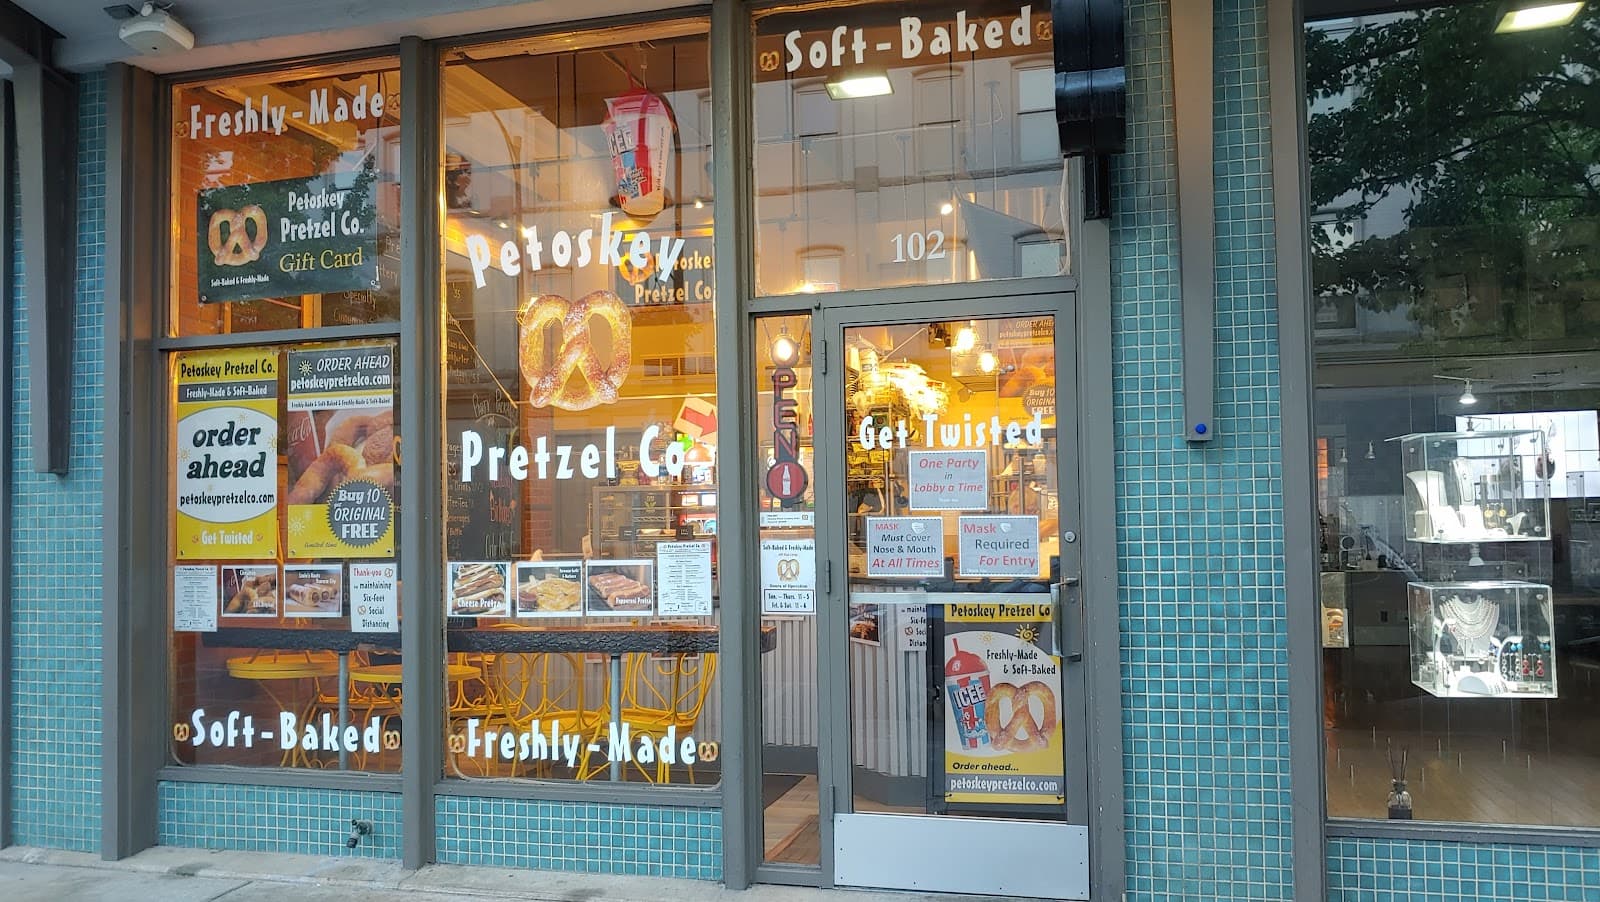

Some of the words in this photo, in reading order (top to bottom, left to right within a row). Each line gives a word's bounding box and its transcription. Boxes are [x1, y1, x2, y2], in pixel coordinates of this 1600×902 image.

[785, 5, 1032, 72] Soft-Baked
[190, 85, 384, 139] Freshly-Made
[288, 189, 345, 212] Petoskey
[280, 214, 336, 242] Pretzel
[340, 212, 364, 235] Co.
[466, 212, 685, 288] Petoskey
[890, 229, 946, 263] 102
[279, 252, 315, 273] Gift
[320, 247, 363, 271] Card
[655, 251, 711, 272] oske
[635, 282, 689, 304] Pretzel
[1016, 320, 1037, 329] ORDER
[181, 360, 221, 378] Petoskey
[224, 359, 258, 376] Pretzel
[261, 358, 275, 374] Co.
[317, 356, 352, 373] ORDER
[354, 354, 390, 371] AHEAD
[290, 372, 391, 392] petoskeypretzelco.com
[186, 386, 226, 399] Freshly-Made
[226, 386, 232, 396] &
[233, 385, 267, 396] Soft-Baked
[1029, 389, 1045, 397] Buy
[1046, 388, 1055, 397] 10
[1032, 406, 1055, 415] FREE
[193, 421, 261, 447] order
[859, 416, 909, 450] Get
[922, 412, 1042, 448] Twisted
[461, 426, 615, 482] Pretzel
[639, 425, 685, 477] Co
[186, 452, 266, 479] ahead
[919, 458, 943, 469] One
[946, 457, 979, 470] Party
[914, 483, 945, 494] Lobby
[958, 482, 983, 492] Time
[180, 490, 275, 507] petoskeypretzelco.com
[338, 490, 364, 504] Buy
[366, 488, 380, 502] 10
[334, 507, 386, 521] ORIGINAL
[341, 522, 379, 539] FREE
[964, 523, 996, 534] Mask
[202, 530, 218, 545] Get
[220, 530, 253, 545] Twisted
[881, 534, 904, 542] Must
[905, 534, 931, 542] Cover
[975, 538, 1030, 550] Required
[873, 545, 895, 553] Nose
[897, 545, 904, 553] &
[907, 545, 937, 553] Mouth
[872, 558, 884, 568] At
[888, 558, 902, 568] All
[906, 557, 939, 568] Times
[979, 555, 999, 565] For
[1002, 555, 1036, 569] Entry
[353, 568, 382, 577] Thank-you
[359, 581, 392, 590] maintaining
[363, 593, 385, 602] Six-feet
[457, 599, 479, 608] Cheese
[368, 606, 385, 615] Social
[951, 604, 995, 619] Petoskey
[999, 604, 1035, 617] Pretzel
[362, 620, 390, 629] Distancing
[986, 649, 1038, 661] Freshly-Made
[1003, 665, 1008, 674] &
[1012, 664, 1056, 675] Soft-Baked
[952, 685, 986, 709] ICEE
[192, 709, 381, 753] Soft-Baked
[467, 718, 697, 768] Freshly-Made
[952, 761, 980, 771] Order
[981, 762, 1019, 771] ahead...
[950, 775, 1058, 794] petoskeypretzelco.com
